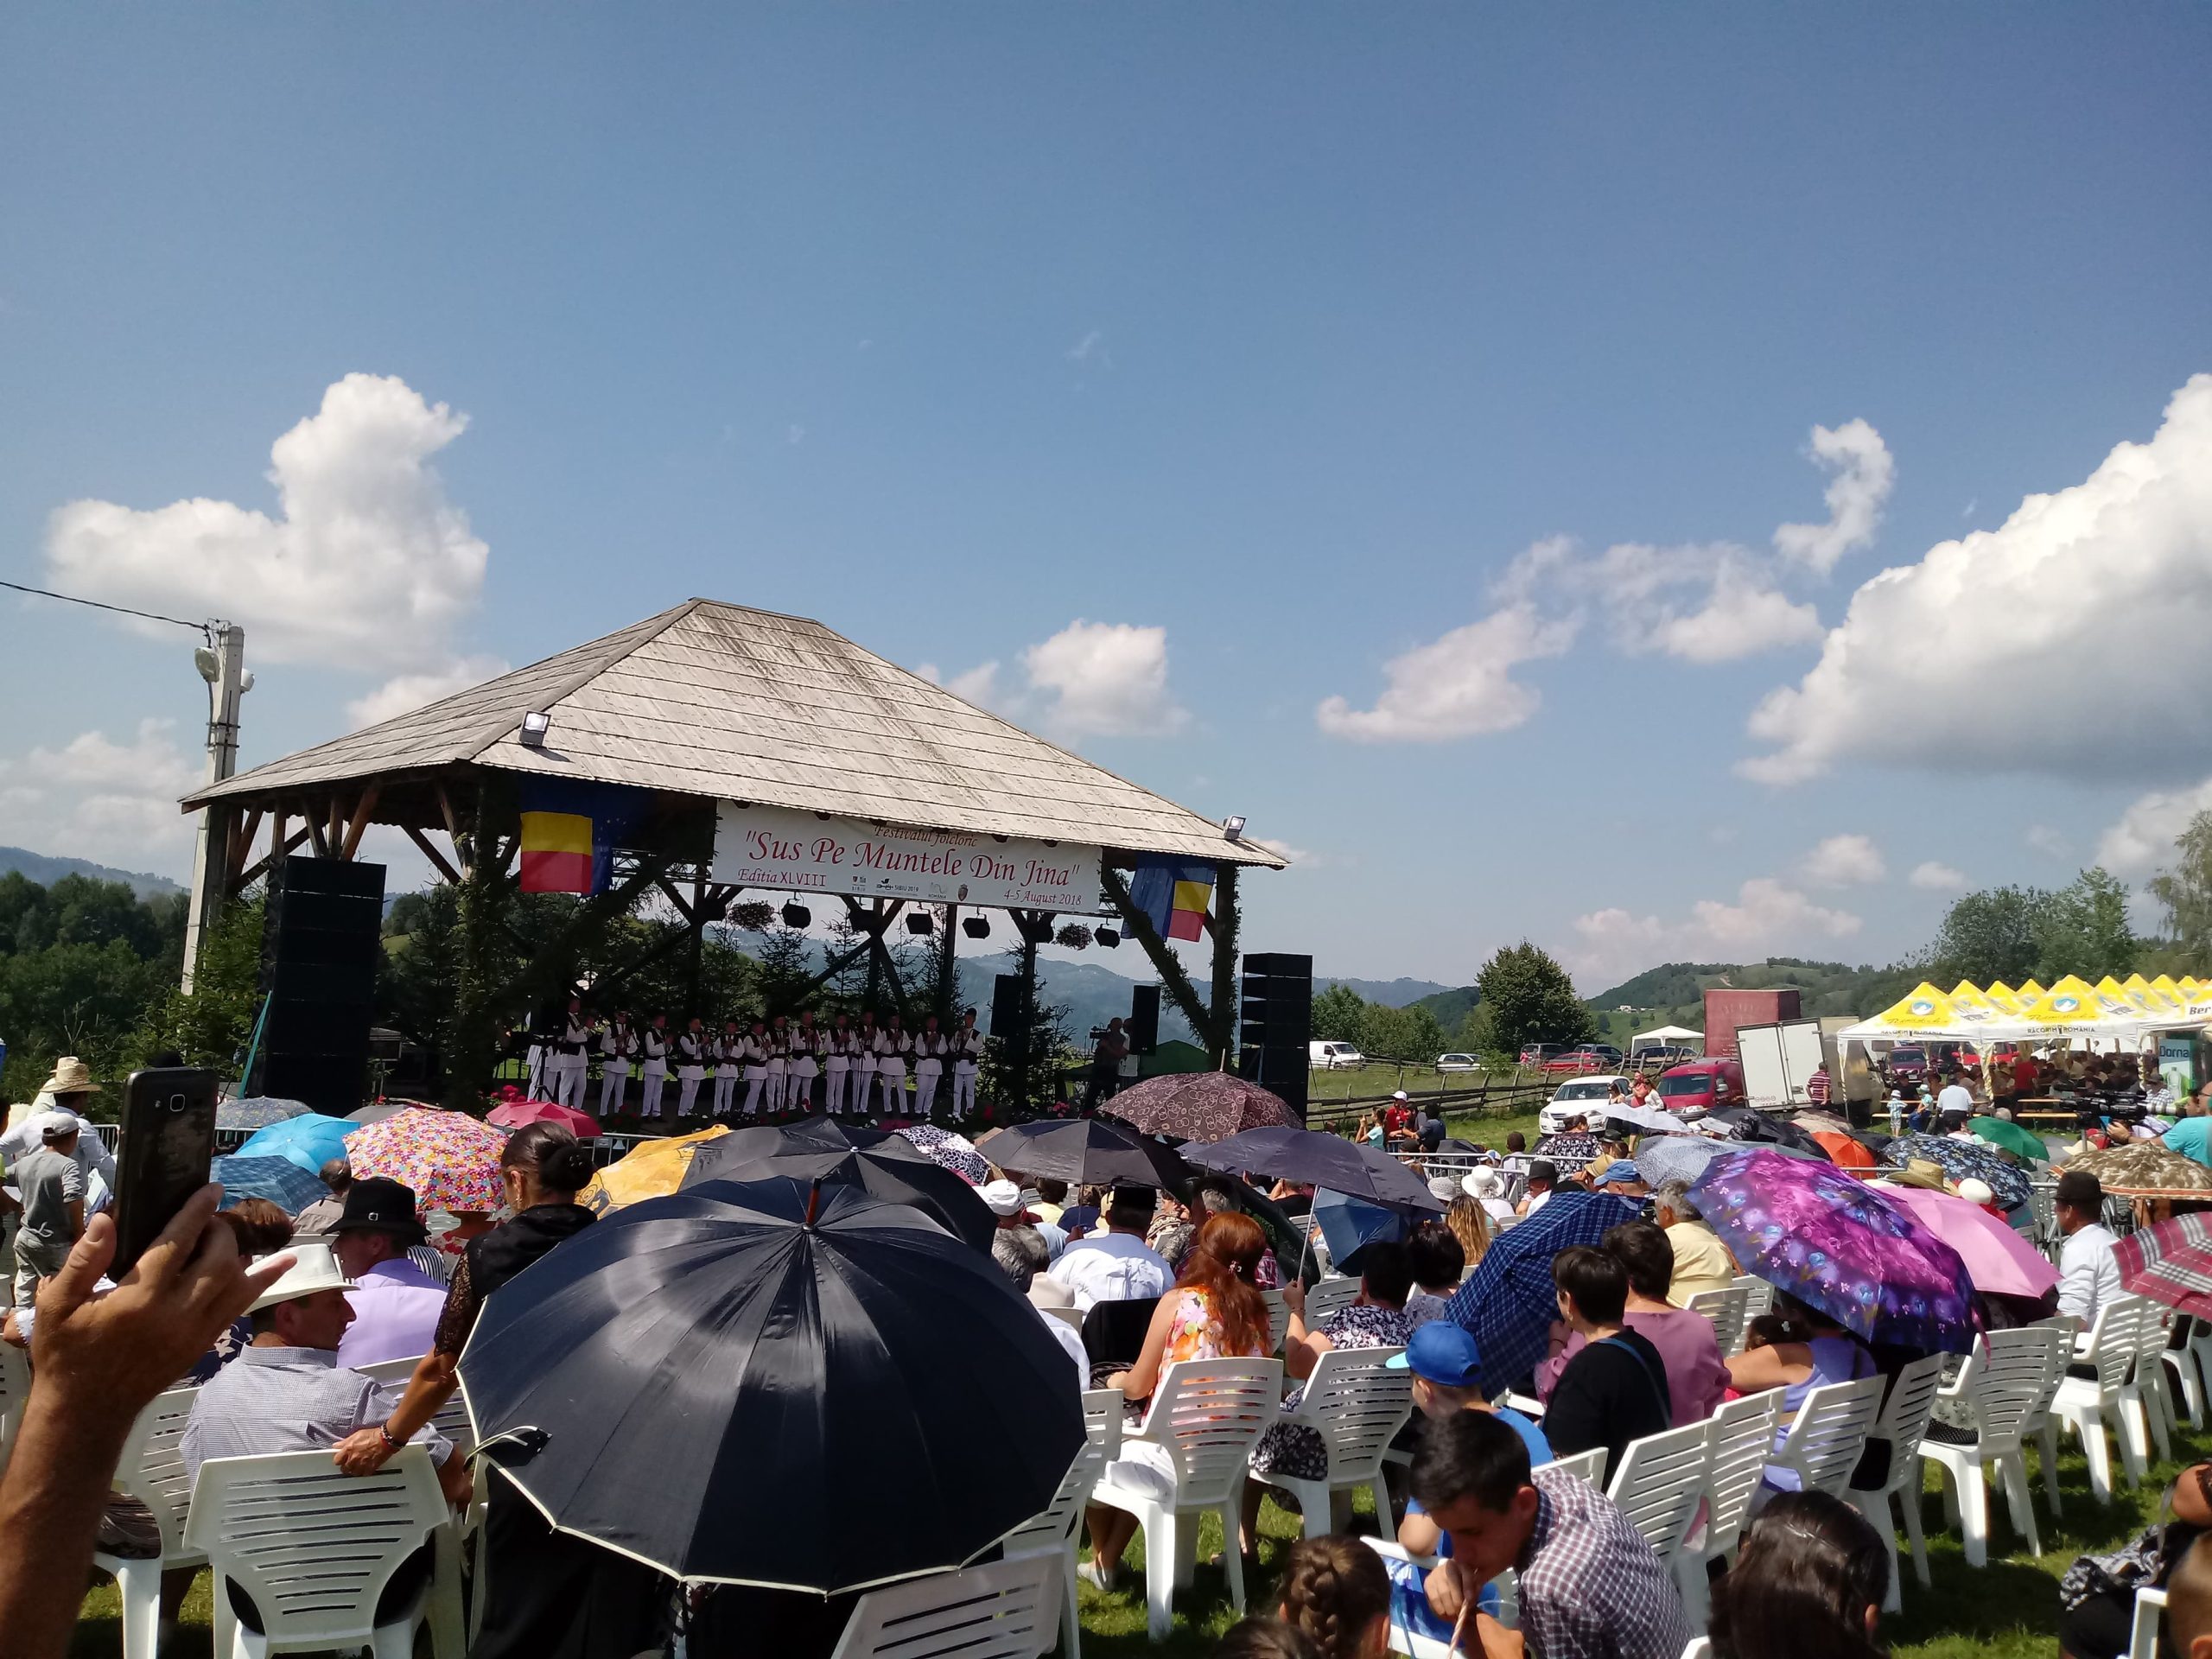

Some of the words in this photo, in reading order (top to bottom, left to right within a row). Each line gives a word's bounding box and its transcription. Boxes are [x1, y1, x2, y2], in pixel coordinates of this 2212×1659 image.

[931, 831, 978, 848] folcloric
[810, 837, 845, 865] Pe
[853, 842, 963, 876] Muntele
[969, 854, 1015, 882] Din
[738, 868, 778, 883] Editia
[779, 870, 827, 887] XLVIII
[1004, 888, 1021, 900] 4-5
[1020, 890, 1057, 906] August
[1058, 893, 1083, 906] 2018
[2159, 1046, 2190, 1058] Dorna
